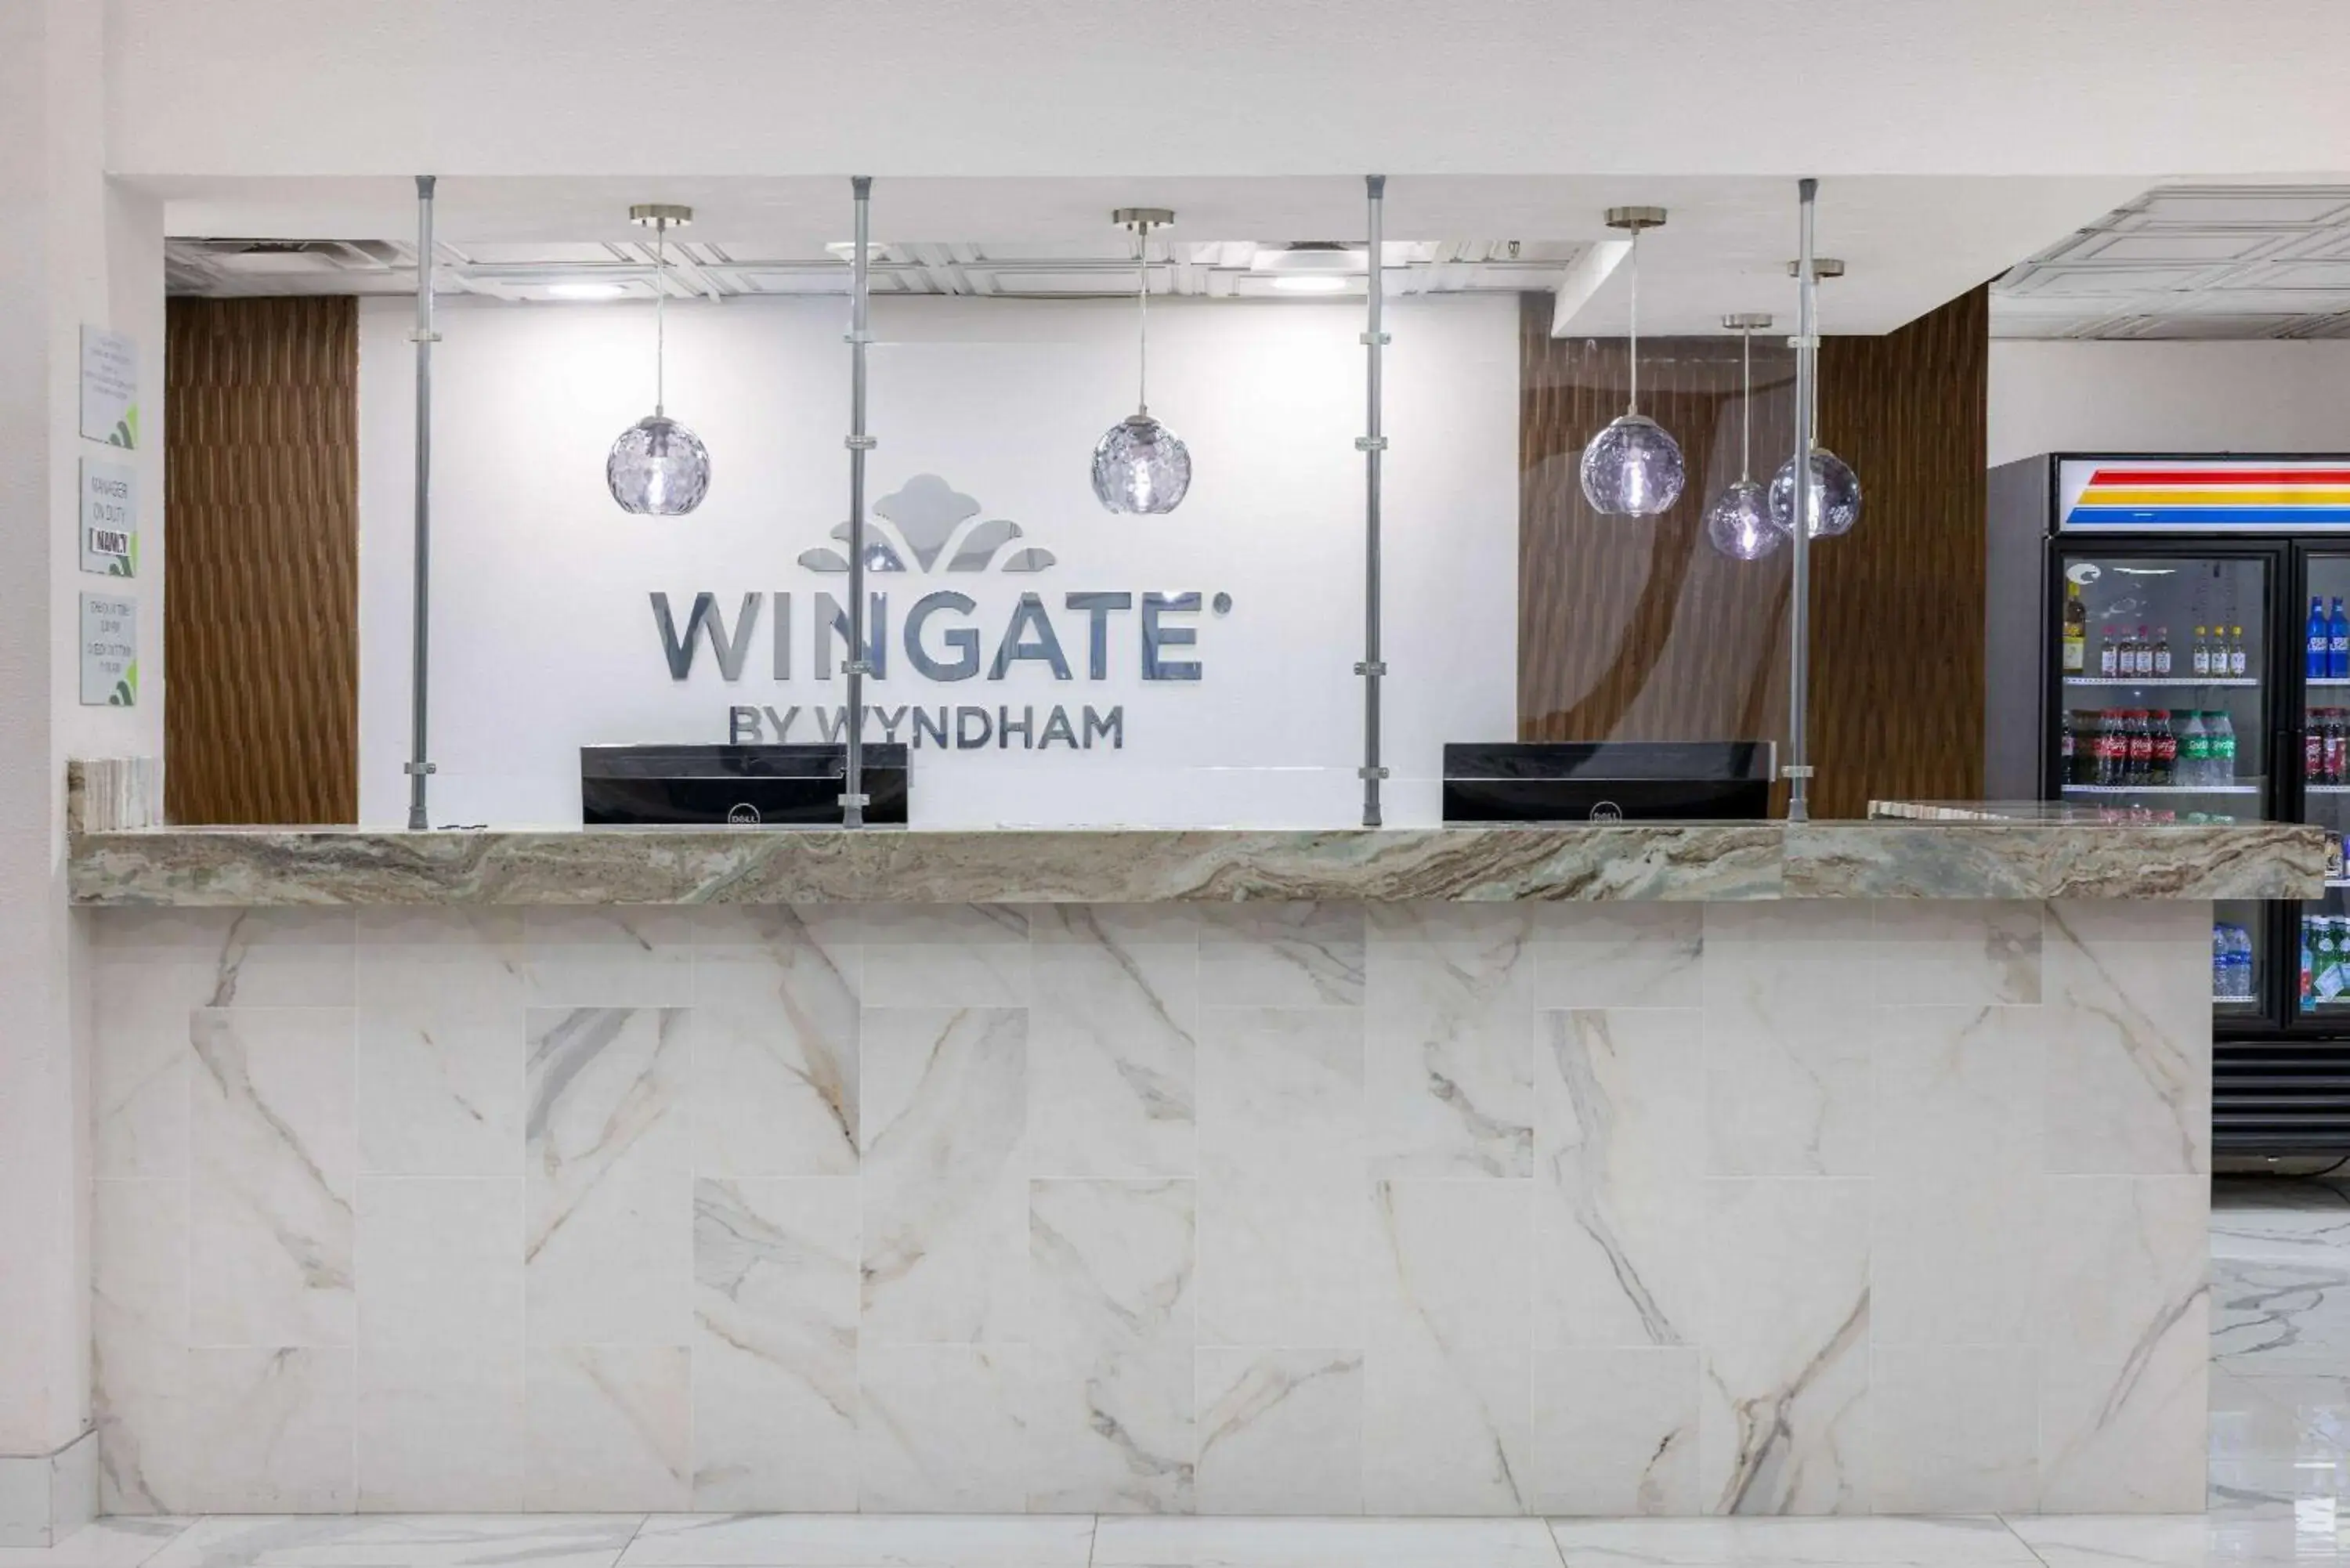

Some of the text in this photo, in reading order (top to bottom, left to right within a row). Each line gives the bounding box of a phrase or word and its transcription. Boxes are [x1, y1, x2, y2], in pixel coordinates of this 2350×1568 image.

[649, 591, 1202, 682] WINGATE
[729, 706, 1124, 750] BY WYNDHAM
